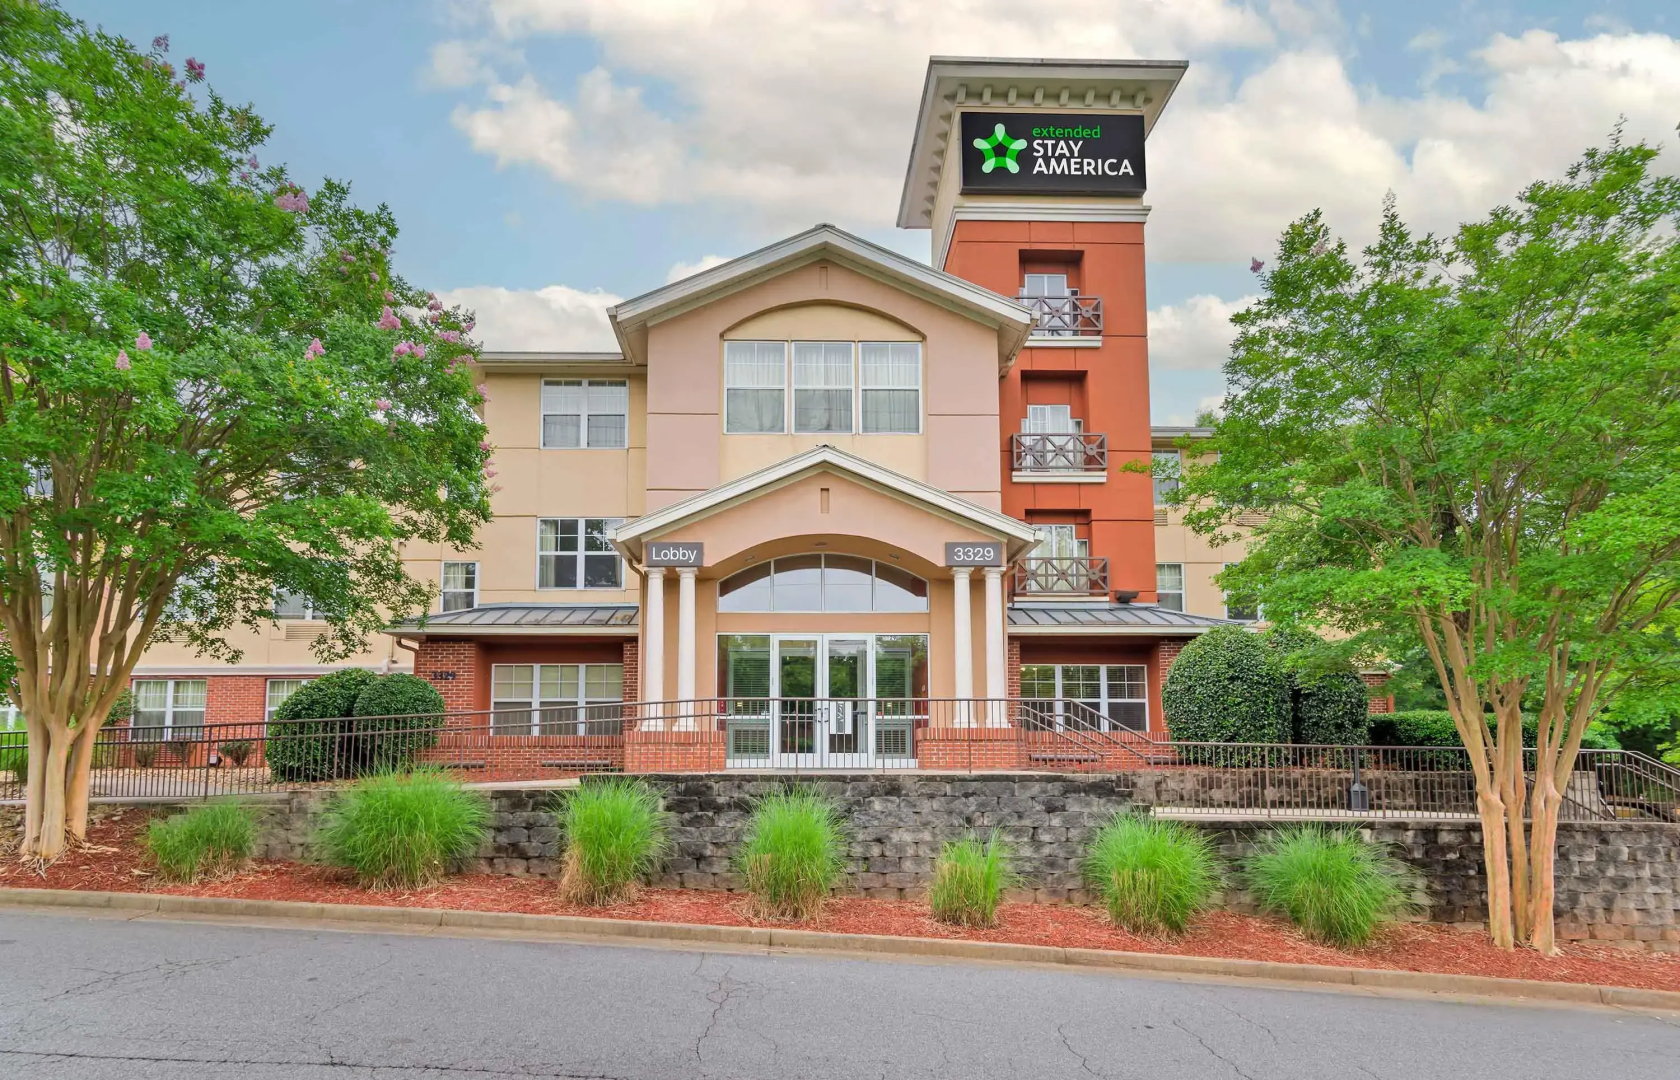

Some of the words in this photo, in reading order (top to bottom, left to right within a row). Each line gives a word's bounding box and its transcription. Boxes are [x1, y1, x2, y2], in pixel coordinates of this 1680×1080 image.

[1032, 125, 1101, 138] extended
[1032, 139, 1083, 157] STAY
[1032, 158, 1135, 176] AMERICA
[652, 547, 697, 563] Lobby
[954, 547, 994, 561] 3329
